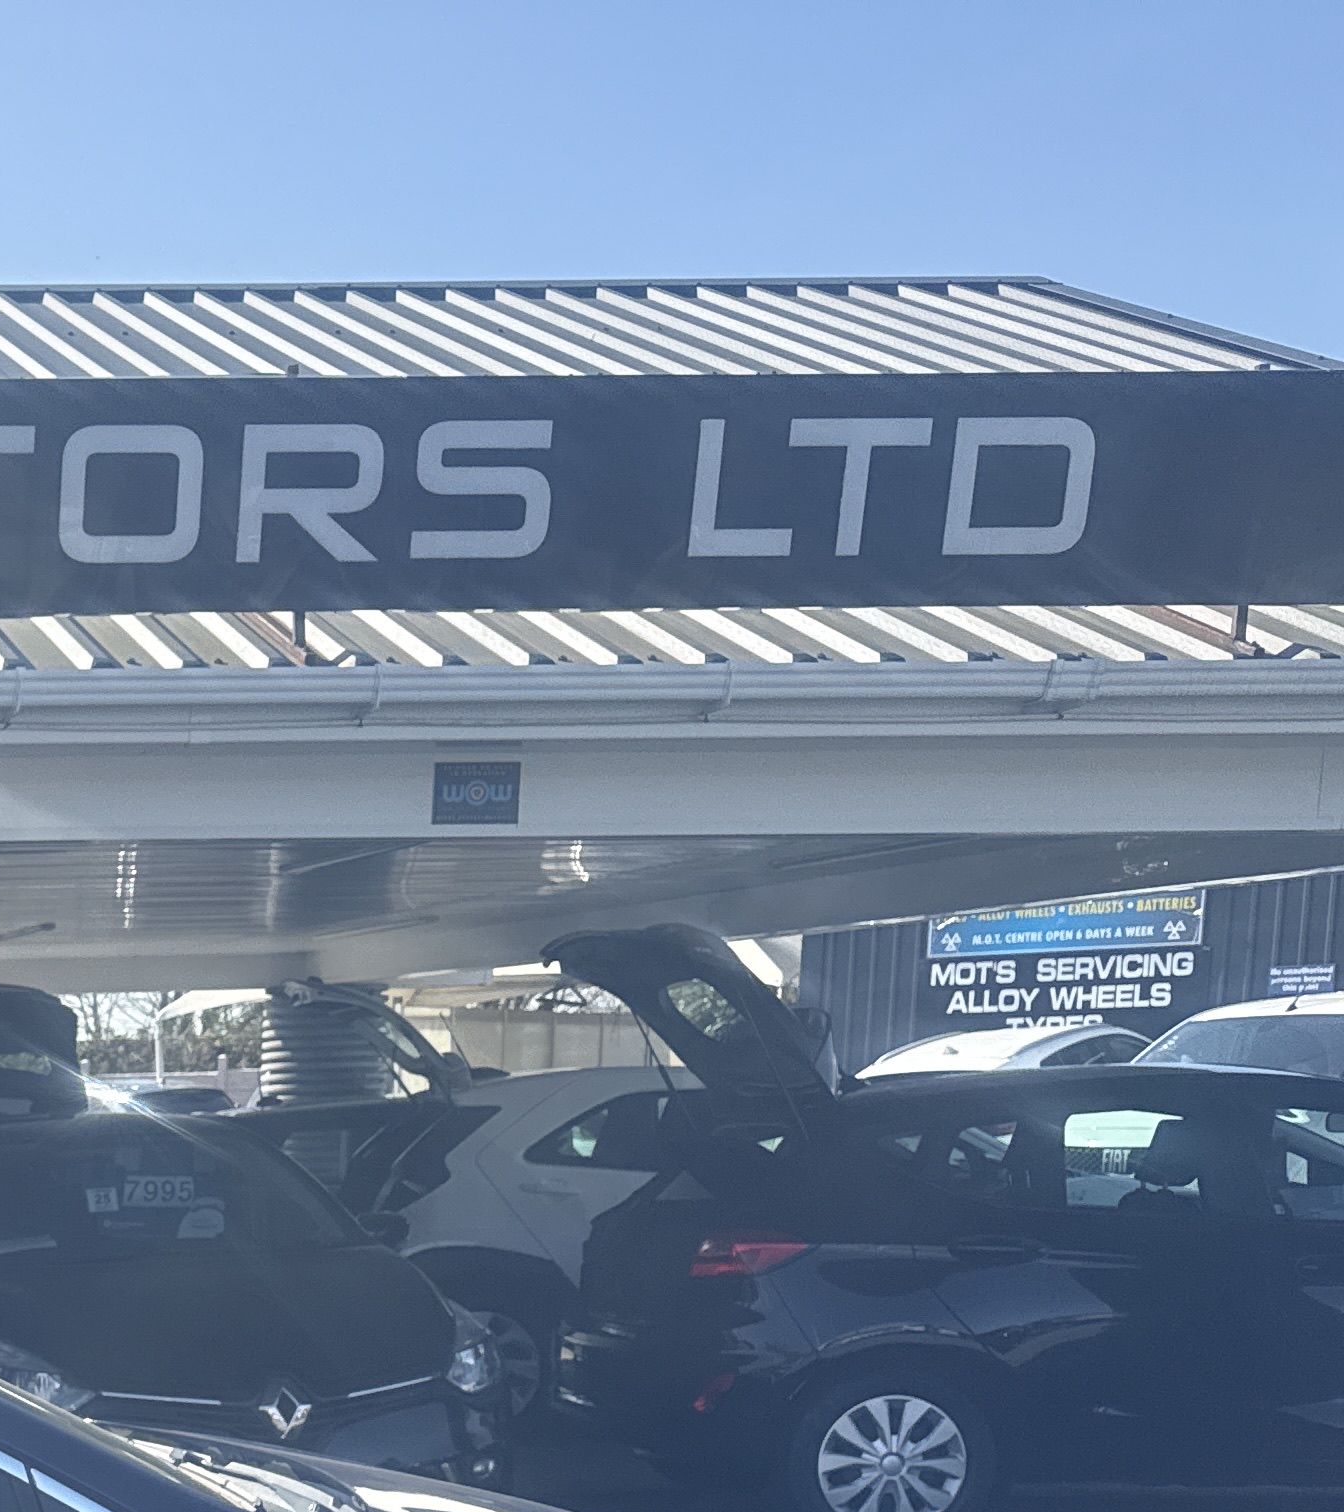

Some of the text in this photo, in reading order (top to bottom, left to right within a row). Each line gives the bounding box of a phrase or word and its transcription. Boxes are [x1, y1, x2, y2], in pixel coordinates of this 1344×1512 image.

[687, 416, 1096, 557] LTD
[1015, 905, 1056, 920] WHEELS
[1068, 900, 1124, 916] EXHAUSTS
[1136, 896, 1197, 912] BATTERIES
[1005, 930, 1043, 943] CENTRE
[1045, 928, 1073, 942] OPEN
[1075, 928, 1083, 940] 6
[1085, 927, 1112, 940] DAYS
[1114, 926, 1123, 938] A
[1124, 925, 1155, 938] WEEK
[930, 951, 1194, 987] MOT'S SERVICING
[946, 982, 1172, 1015] ALLOY WHEELS
[1102, 1149, 1131, 1173] FIAT
[124, 1180, 192, 1203] 7995
